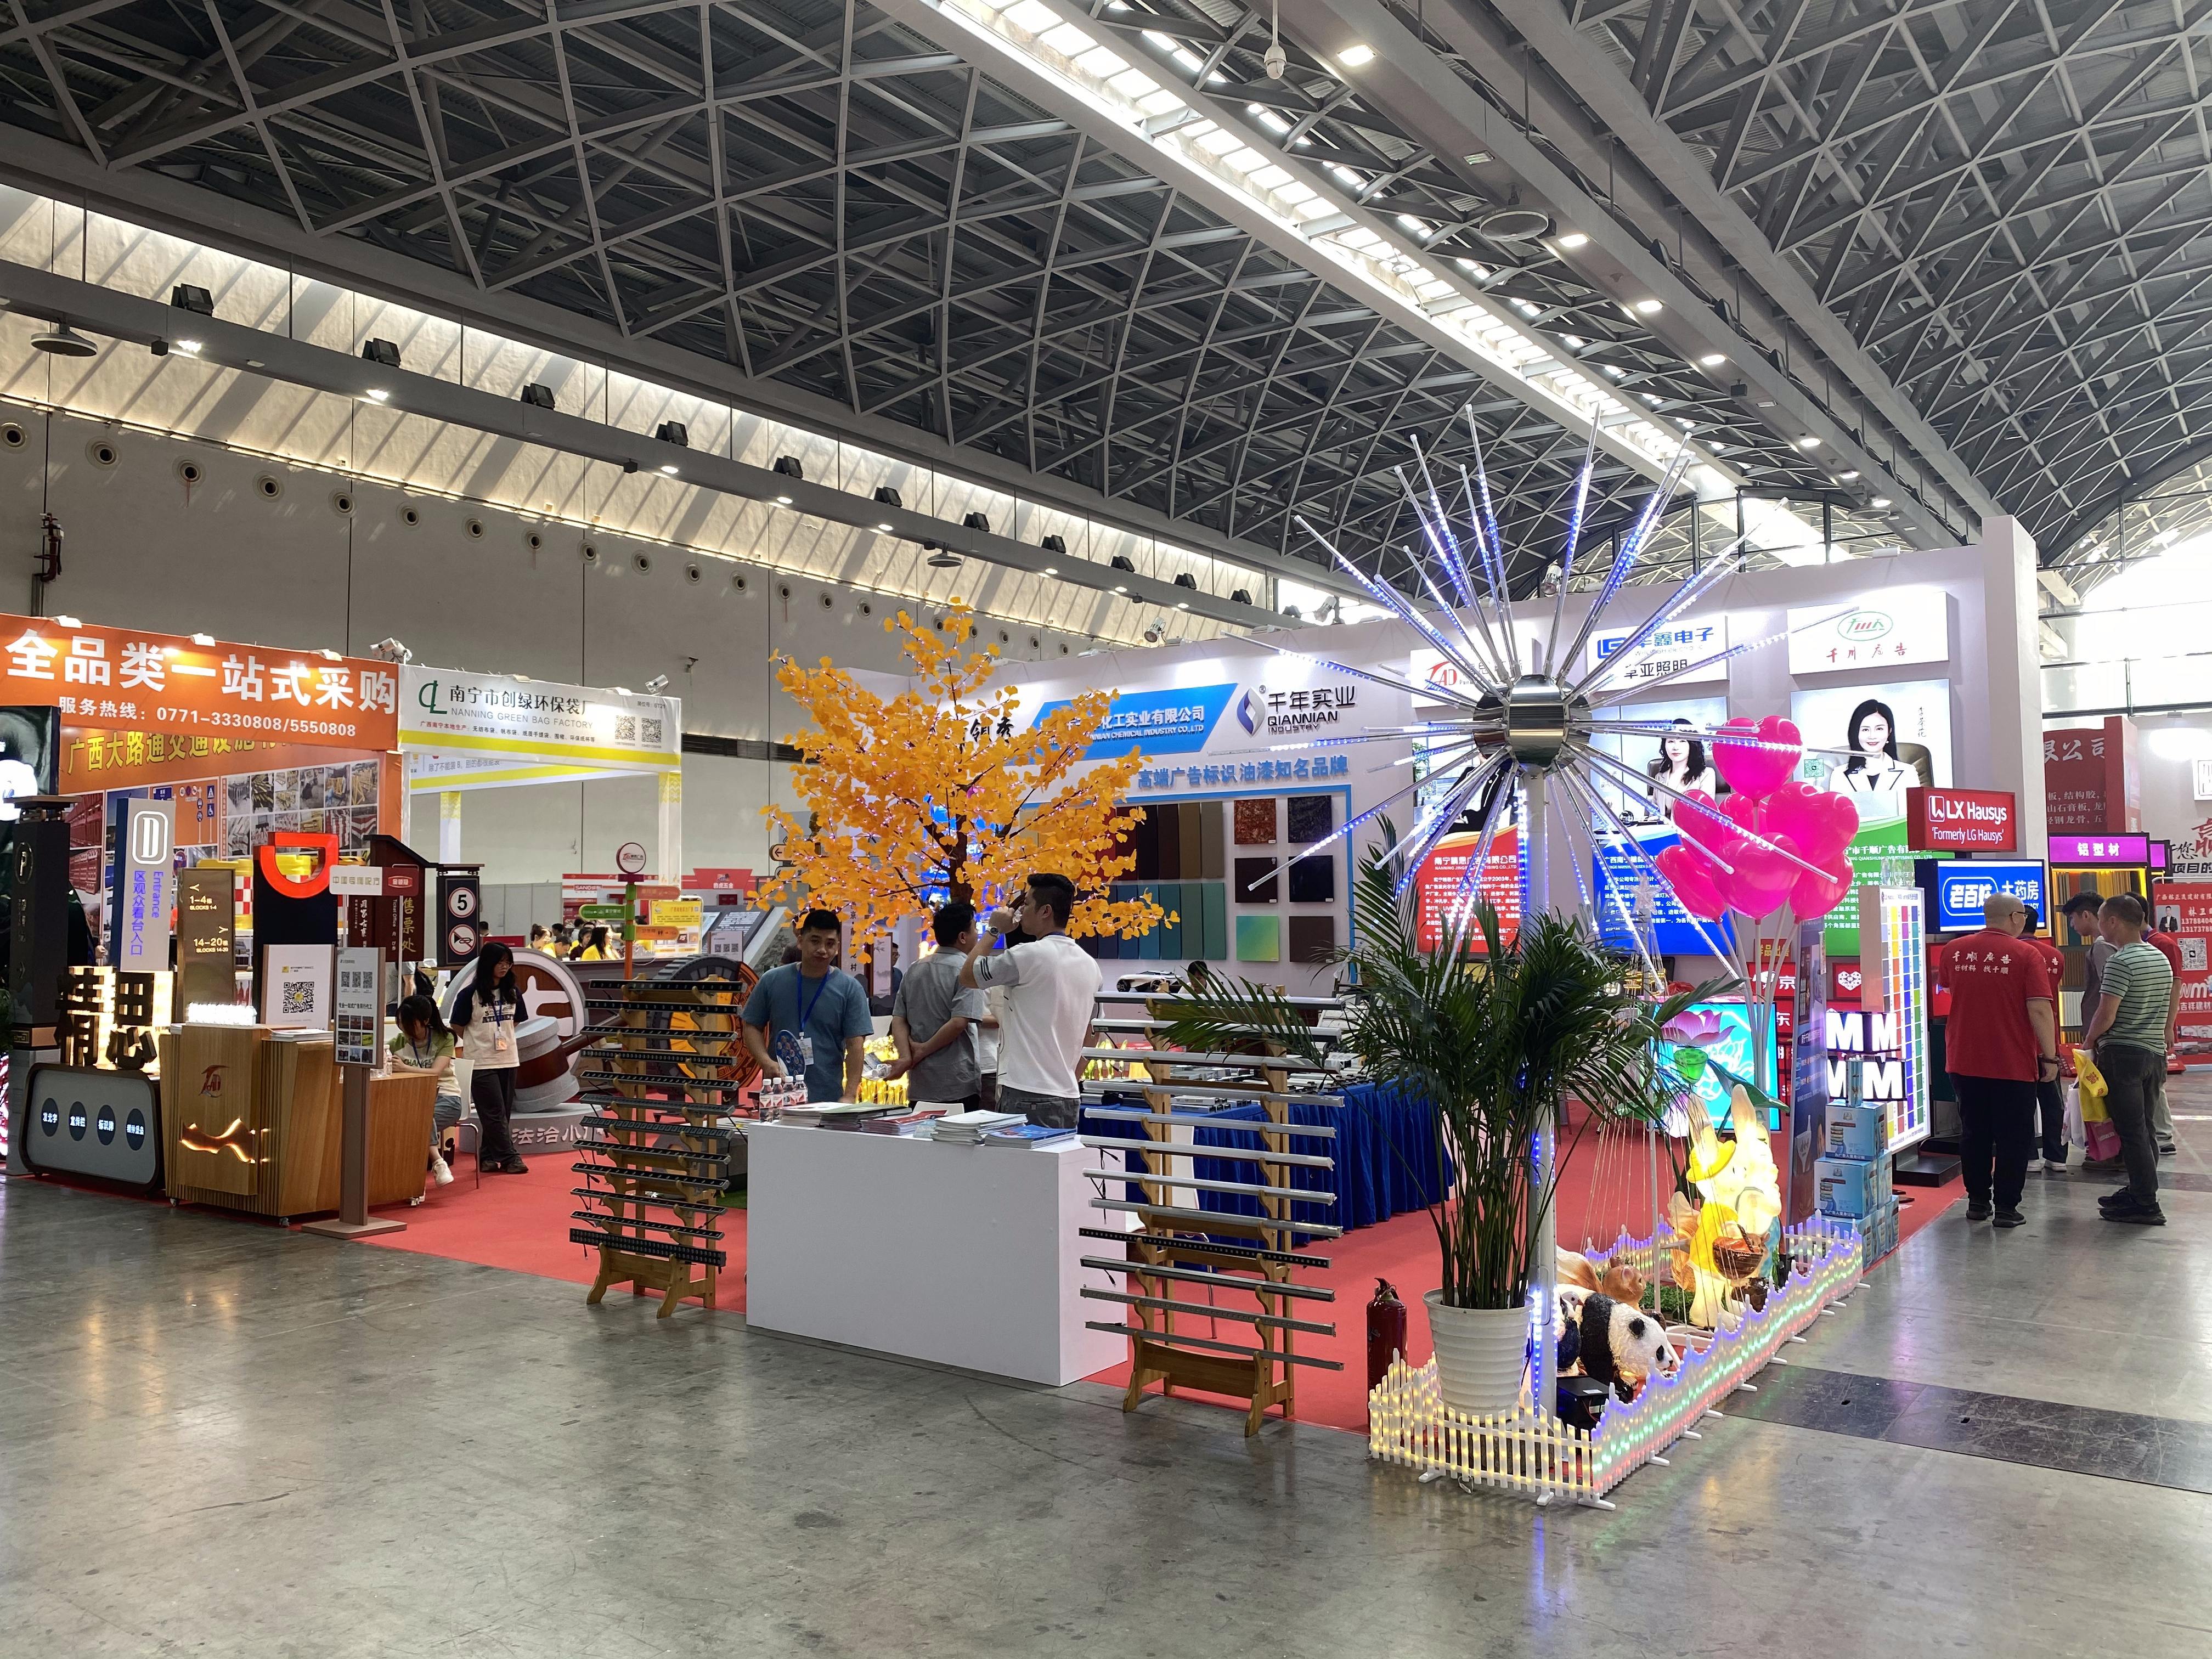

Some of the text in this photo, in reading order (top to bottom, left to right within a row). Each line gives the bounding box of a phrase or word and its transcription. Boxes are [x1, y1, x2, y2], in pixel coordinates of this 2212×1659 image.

[5, 628, 396, 714] 全品类一站式采购
[450, 685, 596, 715] 南宁市创绿环保袋厂
[1268, 686, 1357, 713] 千年实业
[157, 707, 356, 737] 0771-3330808/5550808
[452, 708, 593, 729] NANNING GREEN BAG FACTORY
[1268, 711, 1339, 726] QIANNIAN
[1111, 730, 1142, 738] CHEMICAL
[1144, 727, 1176, 736] INDUSTRY
[1268, 724, 1319, 733] INDUSTRY
[68, 732, 291, 774] 广西大路通交通设施
[2048, 791, 2106, 800] 板，结构胶，
[1946, 800, 2007, 825] LX Hausys
[2047, 802, 2106, 812] 山石膏板，龙
[141, 817, 159, 858] D
[1932, 827, 2004, 844] 'Formerly LG Hausys'
[2077, 843, 2120, 856] 铝型材
[152, 871, 163, 918] Entrance
[457, 894, 467, 911] 5
[402, 898, 416, 952] 售票处
[1779, 975, 1796, 990] 京
[2178, 1002, 2212, 1011] 吉祥建材
